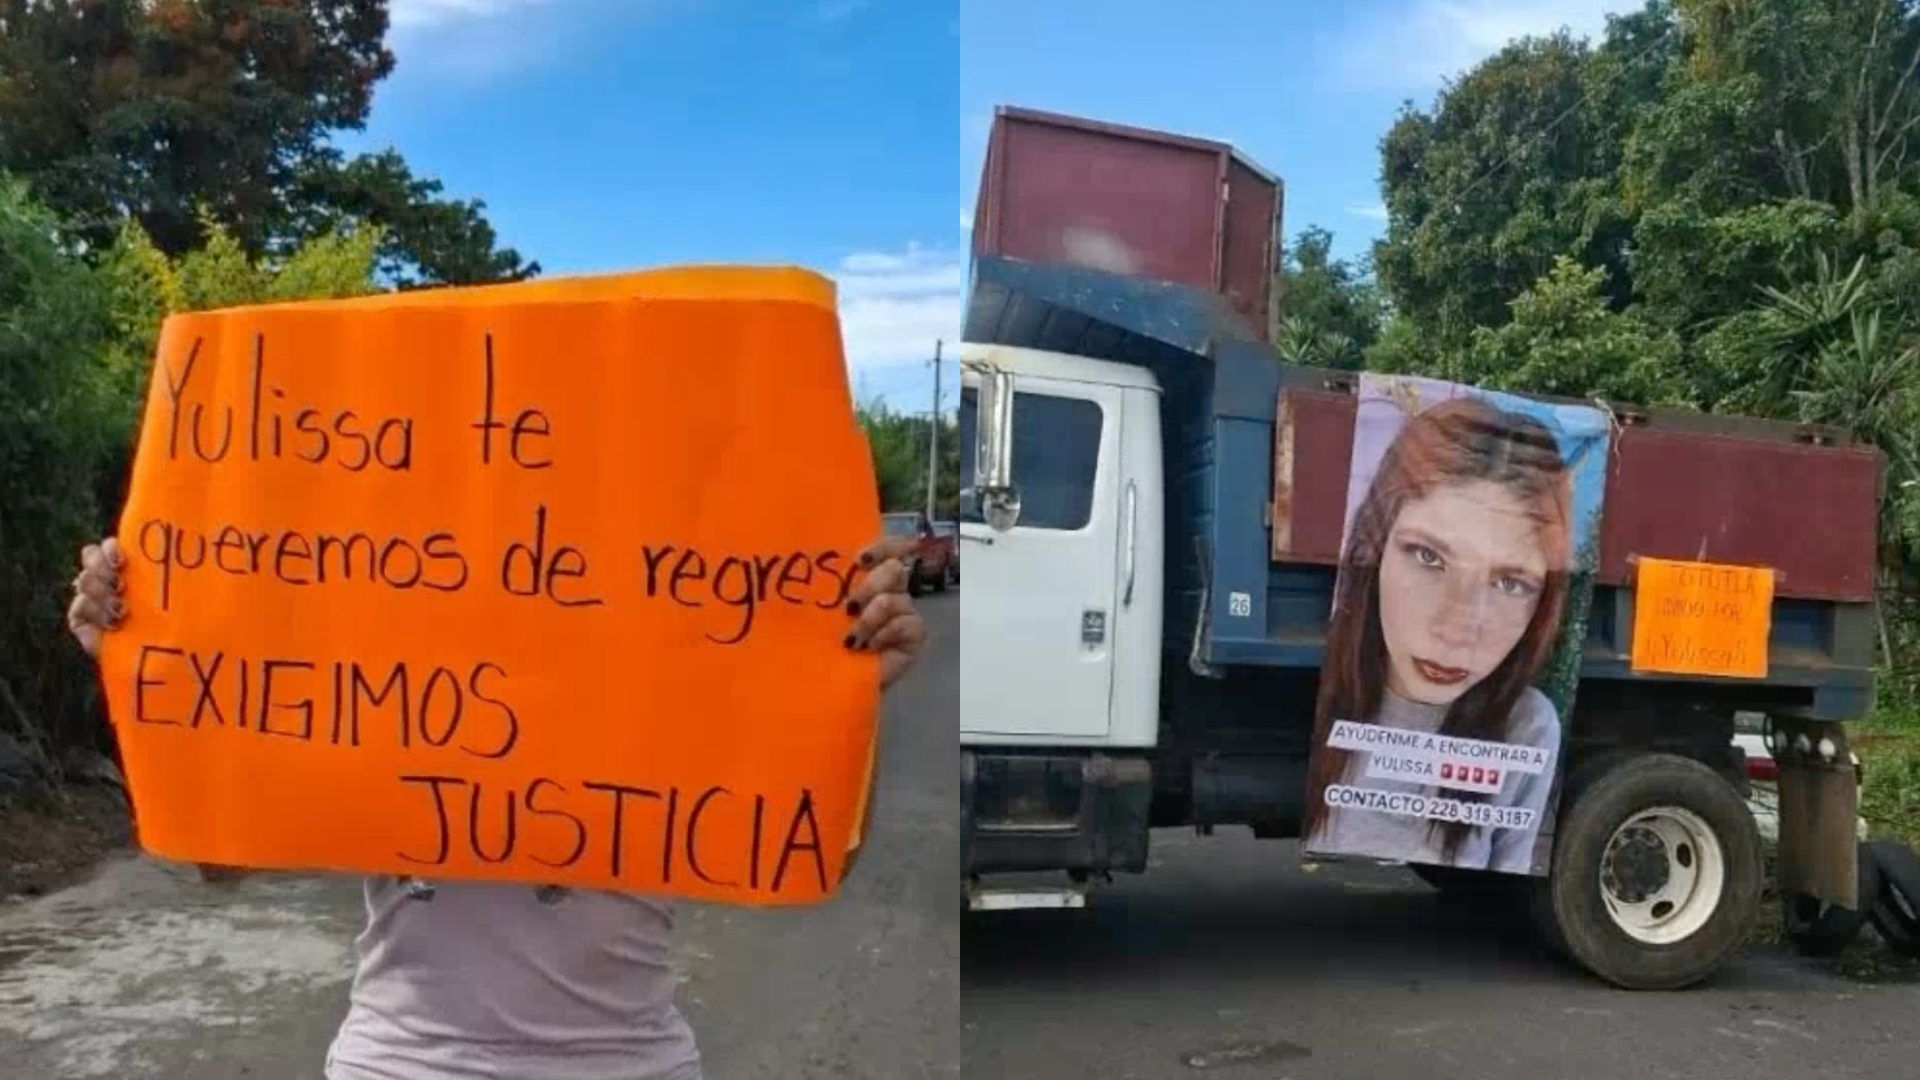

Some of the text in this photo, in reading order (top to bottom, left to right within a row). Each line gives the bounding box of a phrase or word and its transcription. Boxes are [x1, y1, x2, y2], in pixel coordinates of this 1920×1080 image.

[163, 333, 552, 470] Yulissa te
[139, 516, 469, 610] queremos
[502, 505, 604, 606] de
[1232, 599, 1249, 614] 26
[135, 645, 520, 759] EXIGIMOS
[1373, 755, 1434, 775] YULISSA
[1423, 736, 1436, 750] A
[1438, 740, 1529, 762] ENCONTRAR
[1533, 755, 1544, 765] A
[398, 775, 829, 894] JUSTICIA
[1327, 787, 1425, 813] CONTACTO
[1429, 800, 1458, 818] 228
[1464, 807, 1491, 823] 319
